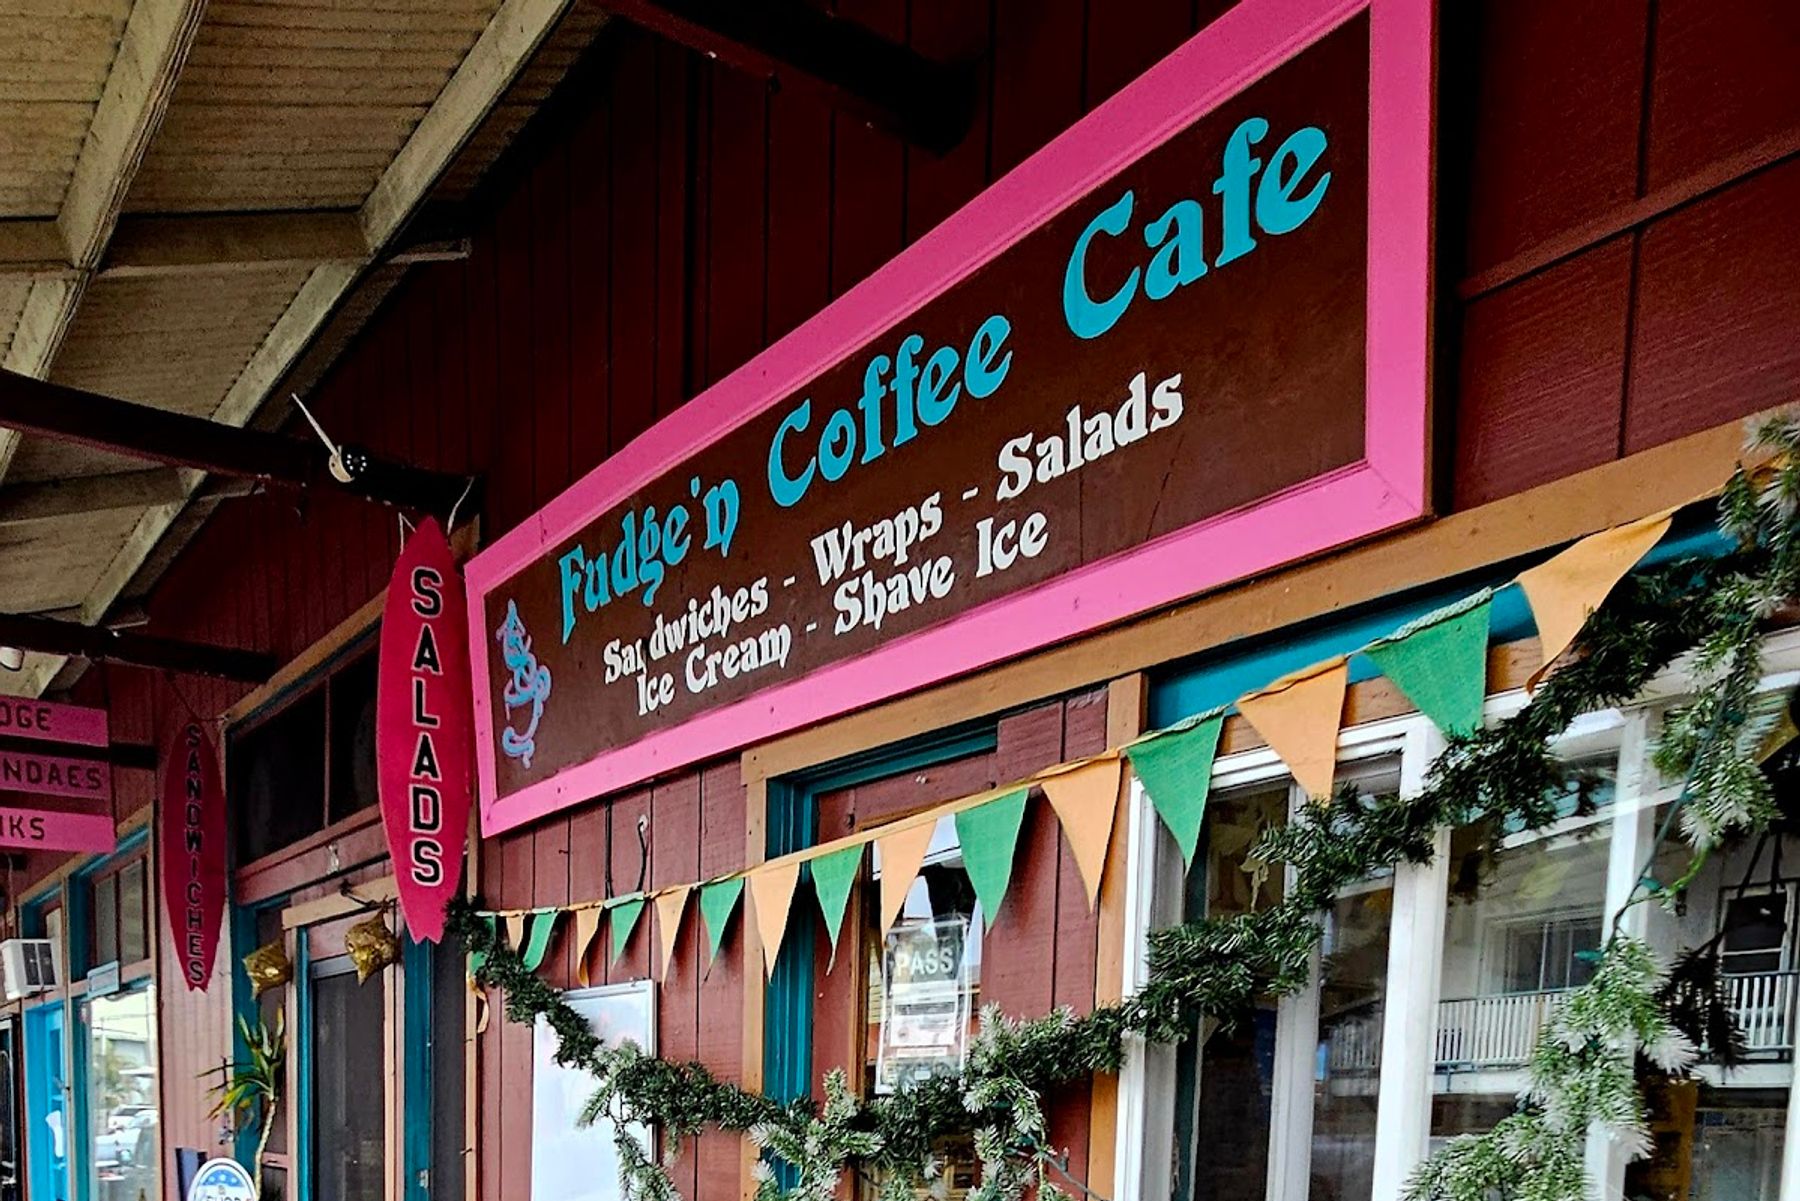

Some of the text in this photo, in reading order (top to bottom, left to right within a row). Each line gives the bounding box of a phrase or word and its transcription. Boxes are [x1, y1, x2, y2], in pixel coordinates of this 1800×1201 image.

[558, 116, 1331, 646] Fudge'n Coffee Cafe
[810, 491, 943, 586] Wraps
[996, 371, 1184, 502] Salads
[637, 672, 676, 716] Ice
[685, 623, 792, 694] Cream
[833, 555, 955, 636] Shave
[975, 511, 1049, 578] Ice
[0, 814, 46, 840] KS
[2, 757, 102, 790] NDAES
[410, 566, 444, 885] SALADS
[185, 723, 207, 986] SANDWICHES
[895, 949, 954, 977] PASS
